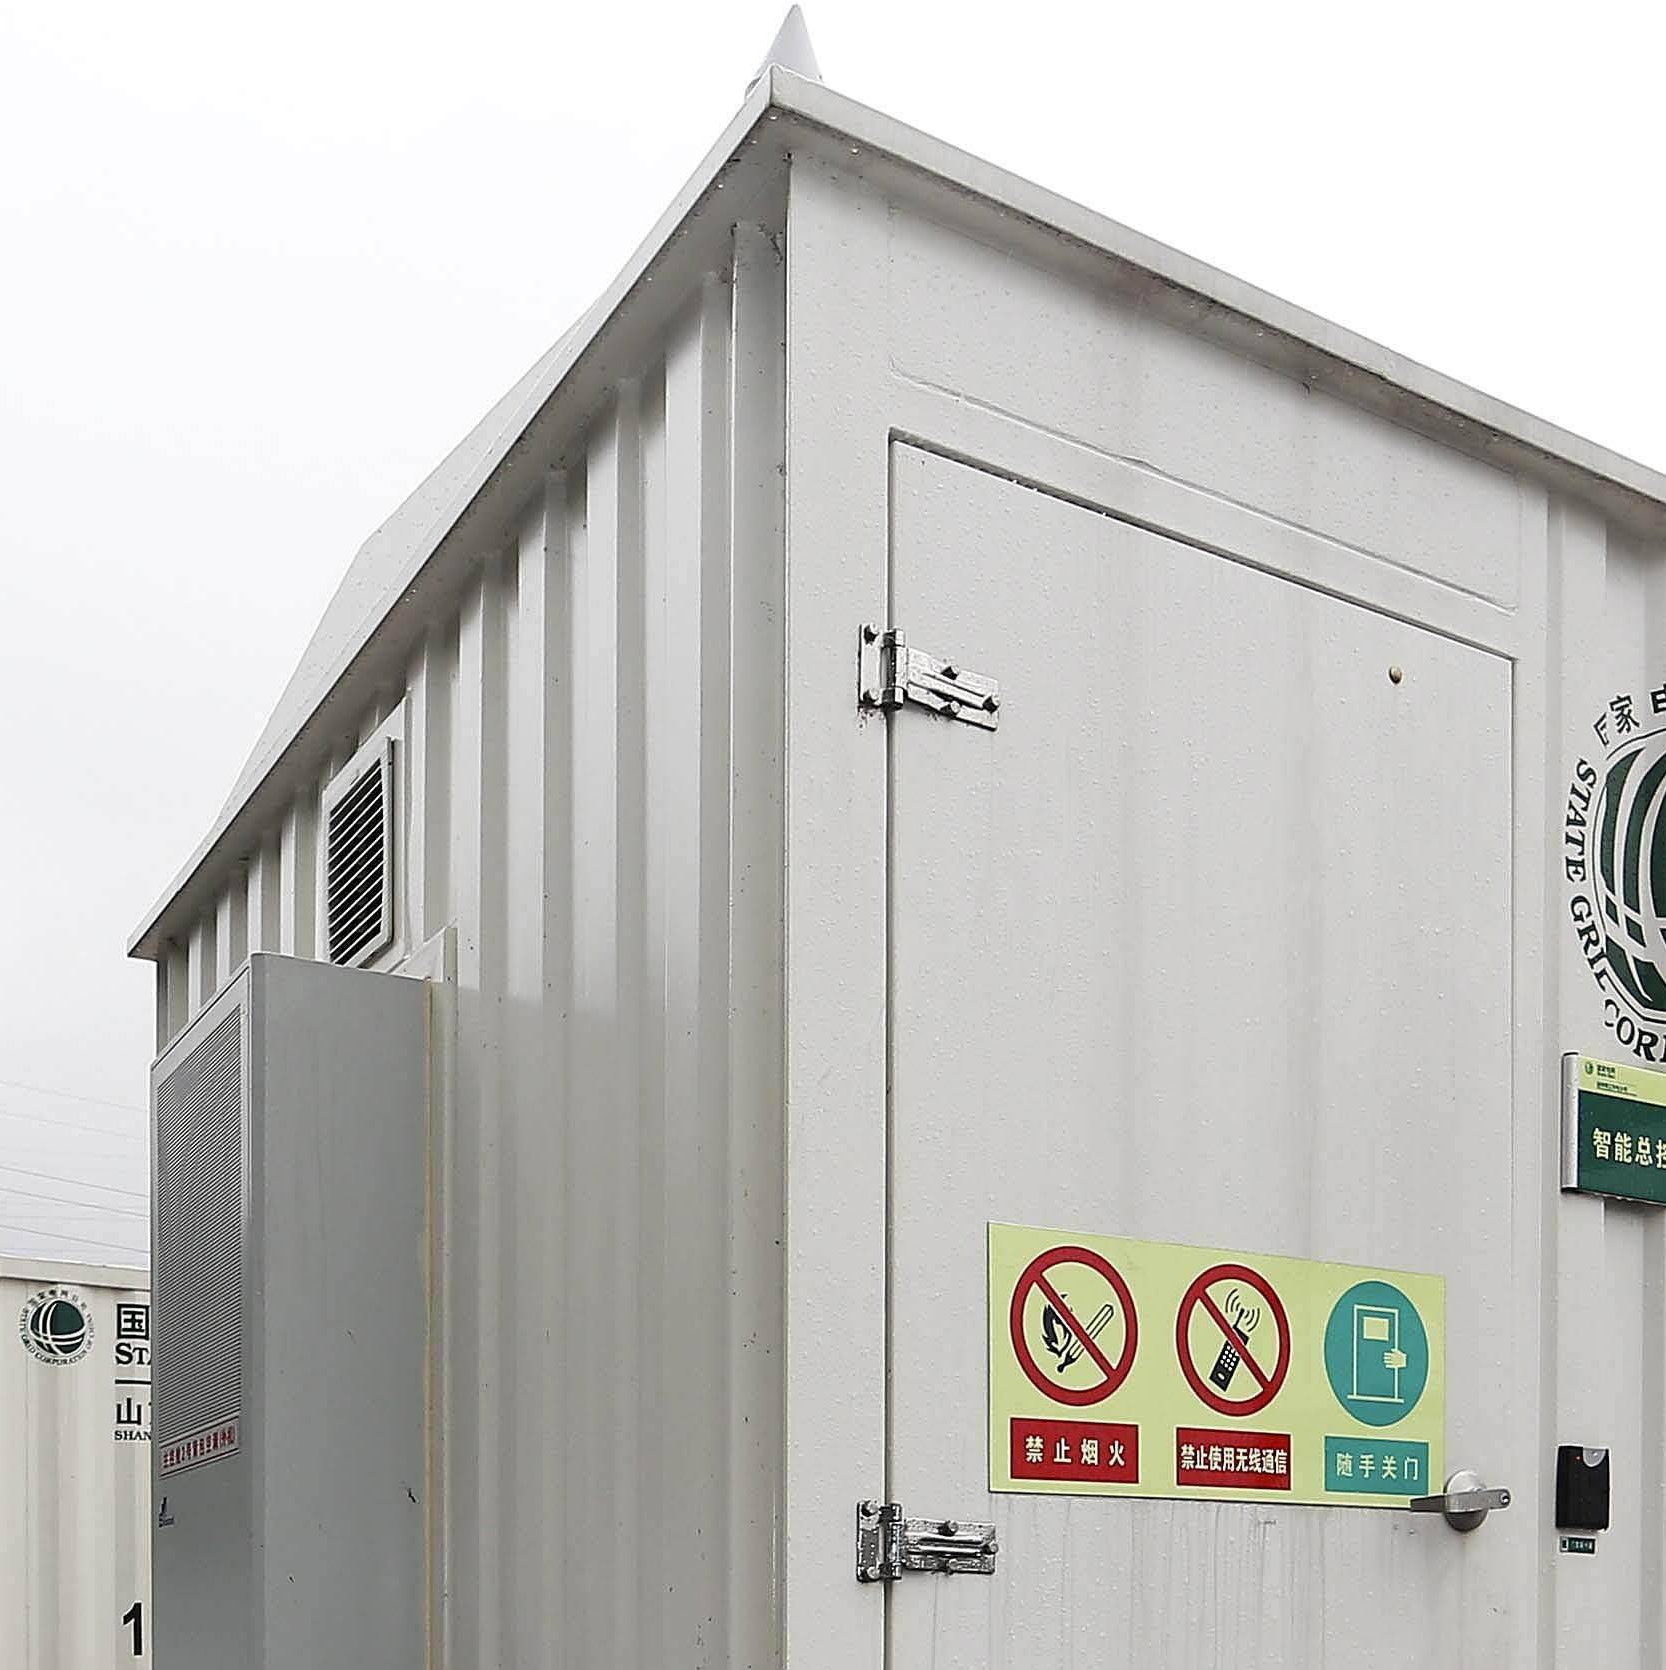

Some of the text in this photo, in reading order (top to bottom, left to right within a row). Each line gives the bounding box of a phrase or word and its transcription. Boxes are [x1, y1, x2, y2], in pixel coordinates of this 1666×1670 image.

[1565, 758, 1597, 883] STATE
[115, 1342, 151, 1365] ST
[1024, 1435, 1126, 1467] 禁止烟火
[1180, 1444, 1288, 1475] 禁止使用无线通信
[1336, 1452, 1419, 1481] 随手关门
